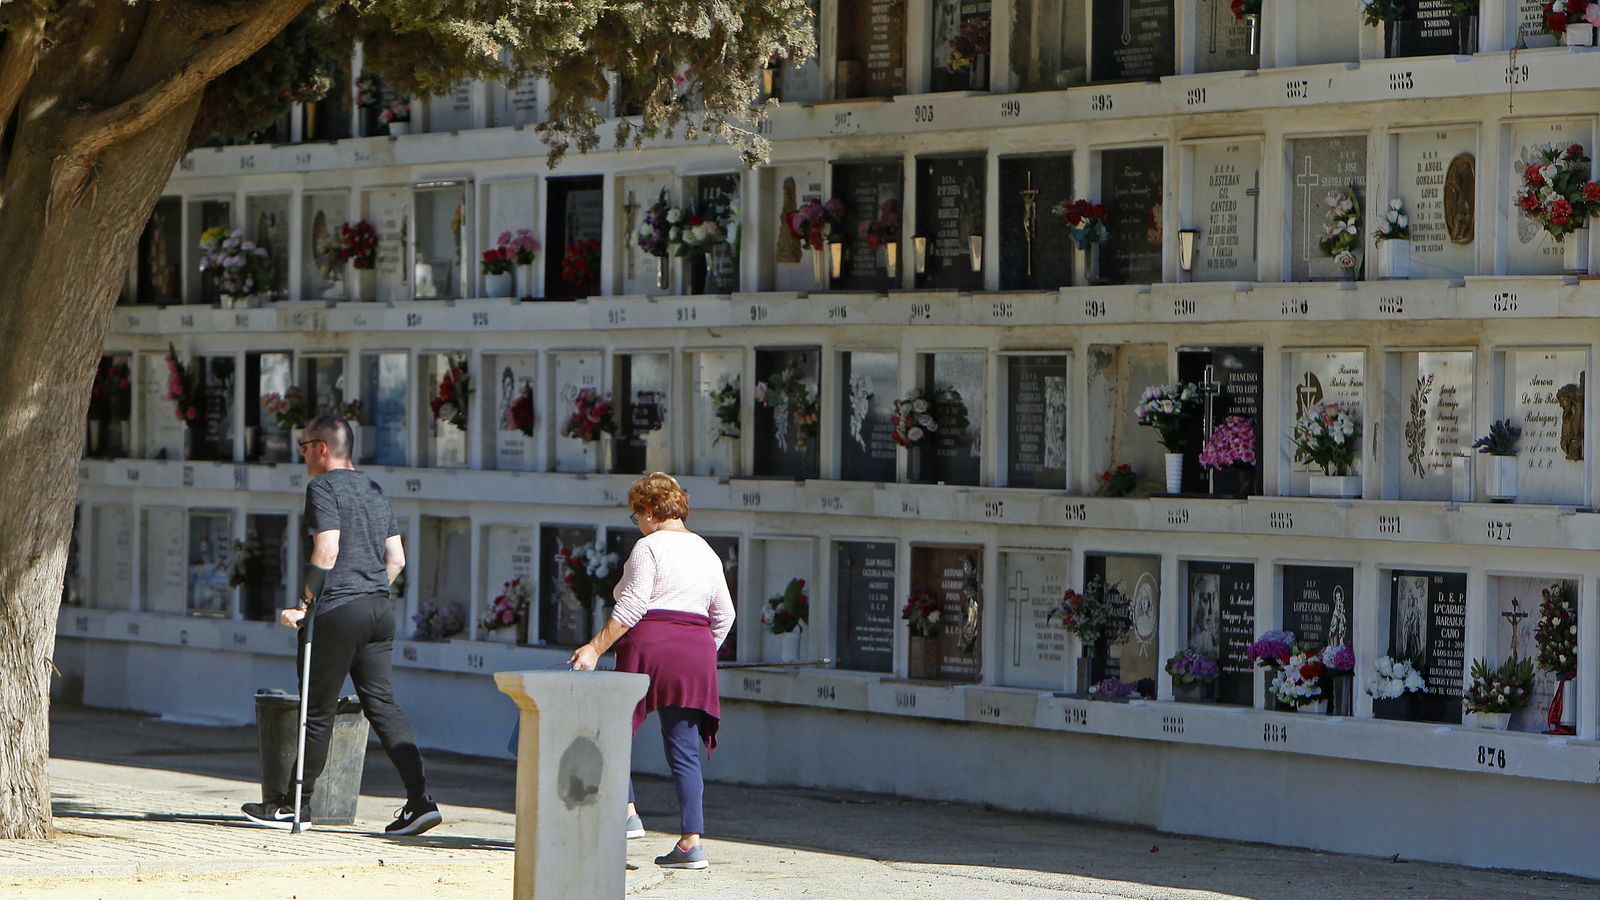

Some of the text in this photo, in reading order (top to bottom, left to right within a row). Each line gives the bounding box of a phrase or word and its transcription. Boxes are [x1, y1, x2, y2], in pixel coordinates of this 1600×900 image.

[1520, 5, 1543, 13] MANTIEN
[1389, 72, 1414, 90] 883
[1504, 64, 1529, 84] 879
[1187, 87, 1206, 105] 891
[1286, 80, 1308, 98] 887
[1001, 100, 1020, 117] 899
[1092, 94, 1113, 111] 895
[915, 105, 934, 122] 903
[1425, 161, 1443, 172] ANGEL
[1415, 175, 1444, 186] GONZALEZ
[1218, 188, 1229, 199] GIL
[1421, 188, 1439, 199] LOPEZ
[1210, 200, 1237, 212] CANTERO
[1543, 247, 1550, 255] NO
[1085, 301, 1106, 317] 894
[1174, 299, 1196, 316] 890
[1379, 296, 1404, 314] 882
[1493, 292, 1520, 311] 878
[992, 302, 1013, 318] 898
[1529, 374, 1553, 386] Aurora
[1521, 392, 1561, 405] De La Ros
[743, 492, 761, 506] 909
[985, 501, 1004, 517] 897
[1167, 509, 1190, 526] 889
[1269, 511, 1294, 528] 885
[1379, 515, 1401, 534] 881
[1487, 521, 1513, 541] 877
[1434, 576, 1444, 584] 880
[1438, 592, 1465, 603] D. E. P.
[1293, 601, 1330, 613] LOPEZ CARNERO
[1434, 604, 1466, 615] DªCARME
[1441, 629, 1460, 639] CANO
[1064, 708, 1087, 725] 892
[1162, 715, 1184, 733] 888
[1263, 722, 1287, 742] 884
[1477, 745, 1506, 768] 876
